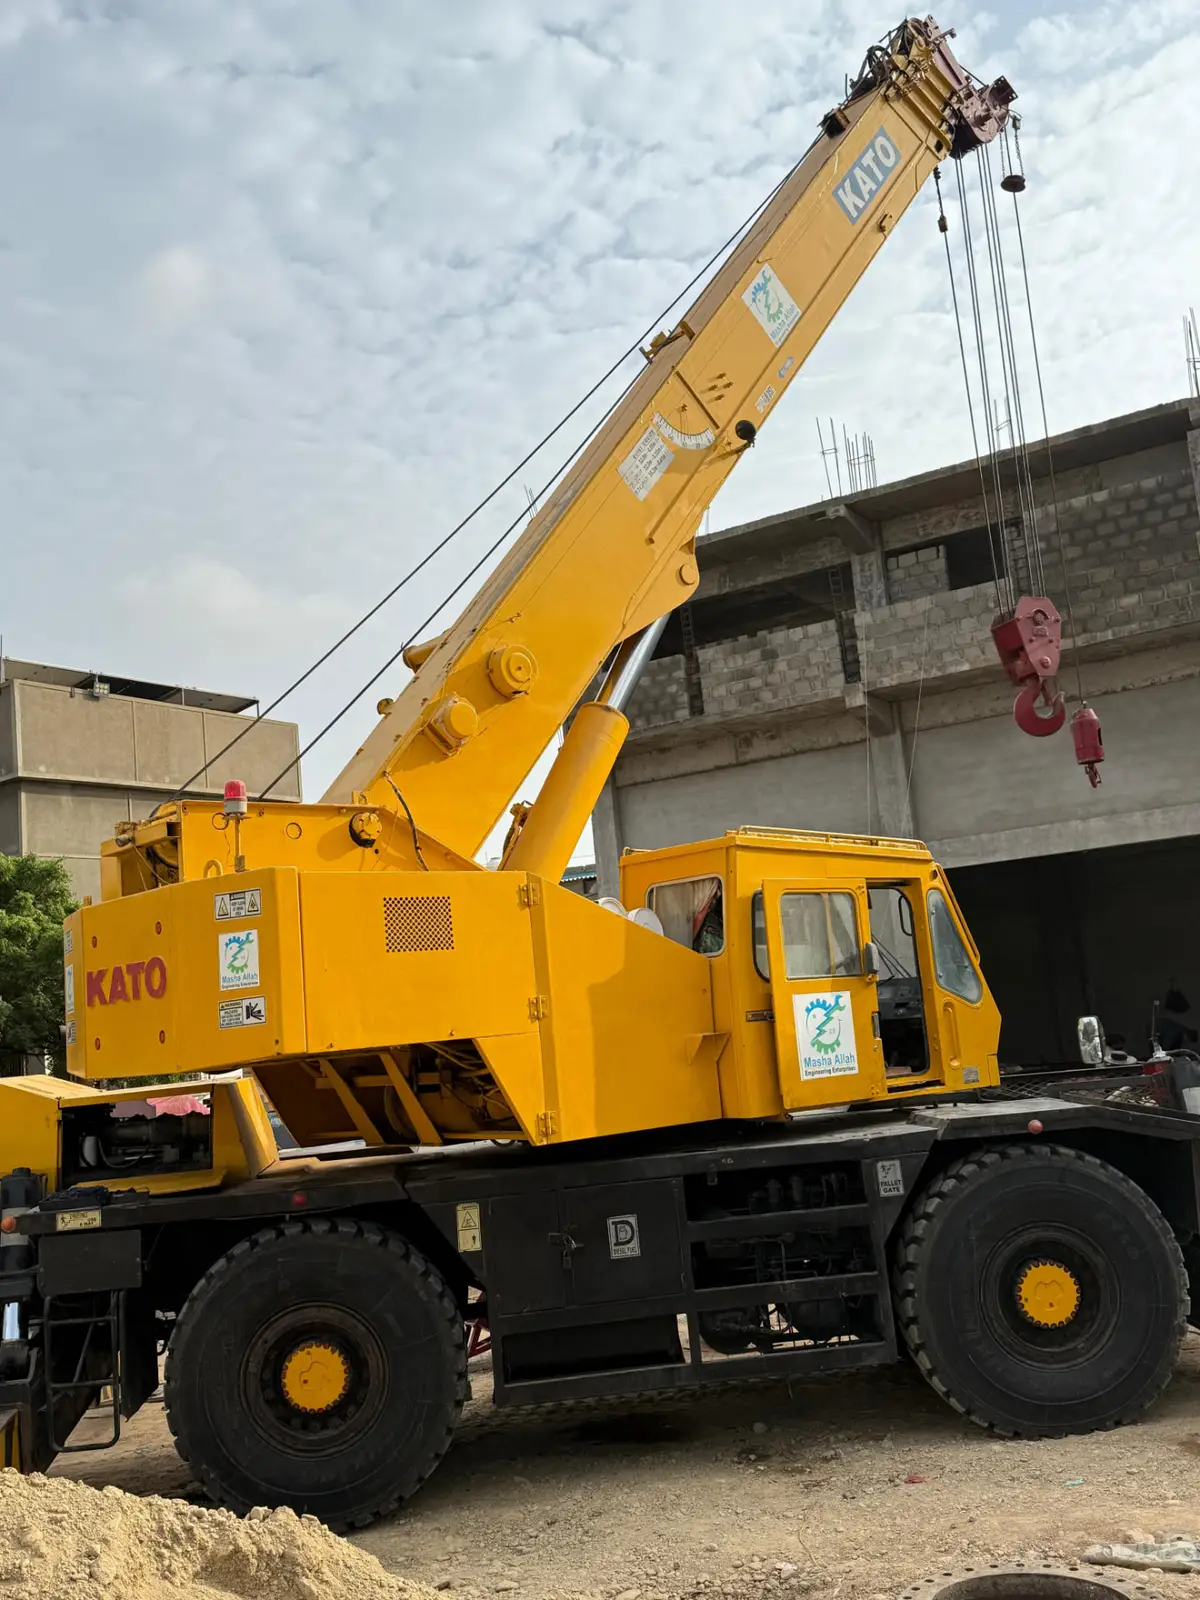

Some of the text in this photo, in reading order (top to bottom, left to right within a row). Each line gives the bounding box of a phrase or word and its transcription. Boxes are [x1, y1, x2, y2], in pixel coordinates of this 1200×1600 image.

[838, 136, 896, 219] KATO
[86, 957, 167, 1008] KATO
[804, 1053, 856, 1068] Masha Allah
[805, 1068, 831, 1077] Engineering
